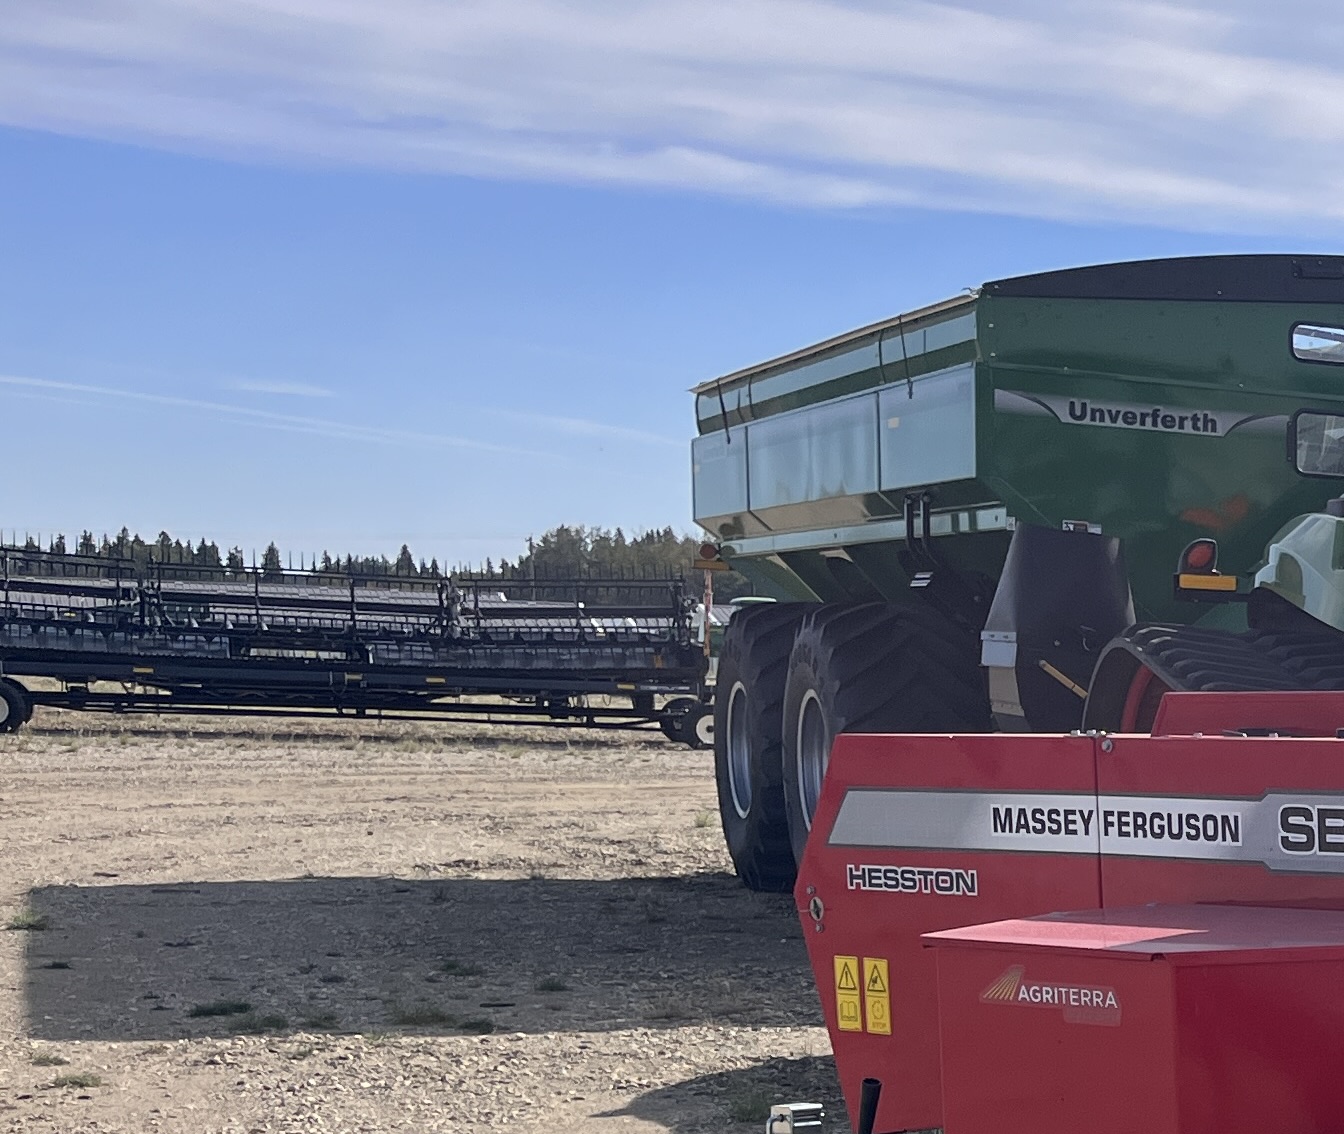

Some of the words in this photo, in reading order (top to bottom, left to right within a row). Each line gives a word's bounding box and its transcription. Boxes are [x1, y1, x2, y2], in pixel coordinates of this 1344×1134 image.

[1068, 400, 1219, 433] Unverferth
[992, 807, 1094, 836] MASSEY
[1103, 810, 1240, 843] FERGUSON
[848, 865, 977, 895] HESSTON
[1018, 985, 1119, 1009] AGRITERRA
